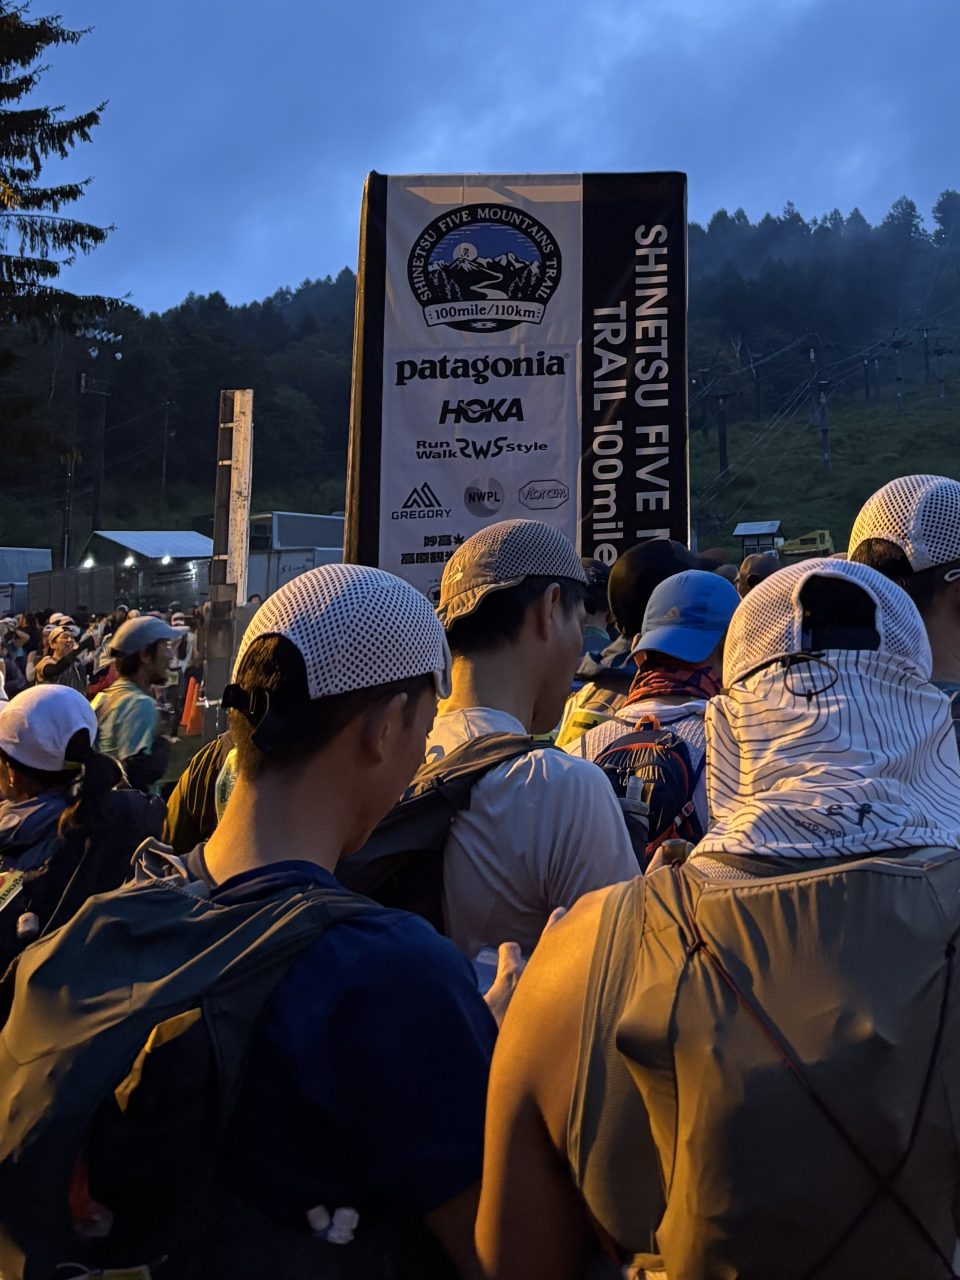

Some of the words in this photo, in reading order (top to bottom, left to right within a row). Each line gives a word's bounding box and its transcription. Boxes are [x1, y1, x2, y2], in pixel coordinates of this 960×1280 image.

[412, 229, 438, 302] SHINETSU
[438, 209, 471, 233] FIVE
[477, 207, 554, 254] MOUNTAINS
[535, 257, 558, 299] TRAIL
[434, 303, 536, 320] 100mile/110km
[634, 224, 669, 408] SHINETSU
[395, 350, 566, 387] patagonia
[592, 300, 627, 411] TRAIL
[438, 398, 525, 425] HOKA
[416, 440, 450, 449] Run
[416, 449, 458, 460] Walk
[505, 441, 549, 454] Style
[635, 424, 670, 512] FIVE
[468, 490, 501, 504] NWPL
[592, 420, 624, 567] 100mile
[391, 509, 452, 520] GREGORY
